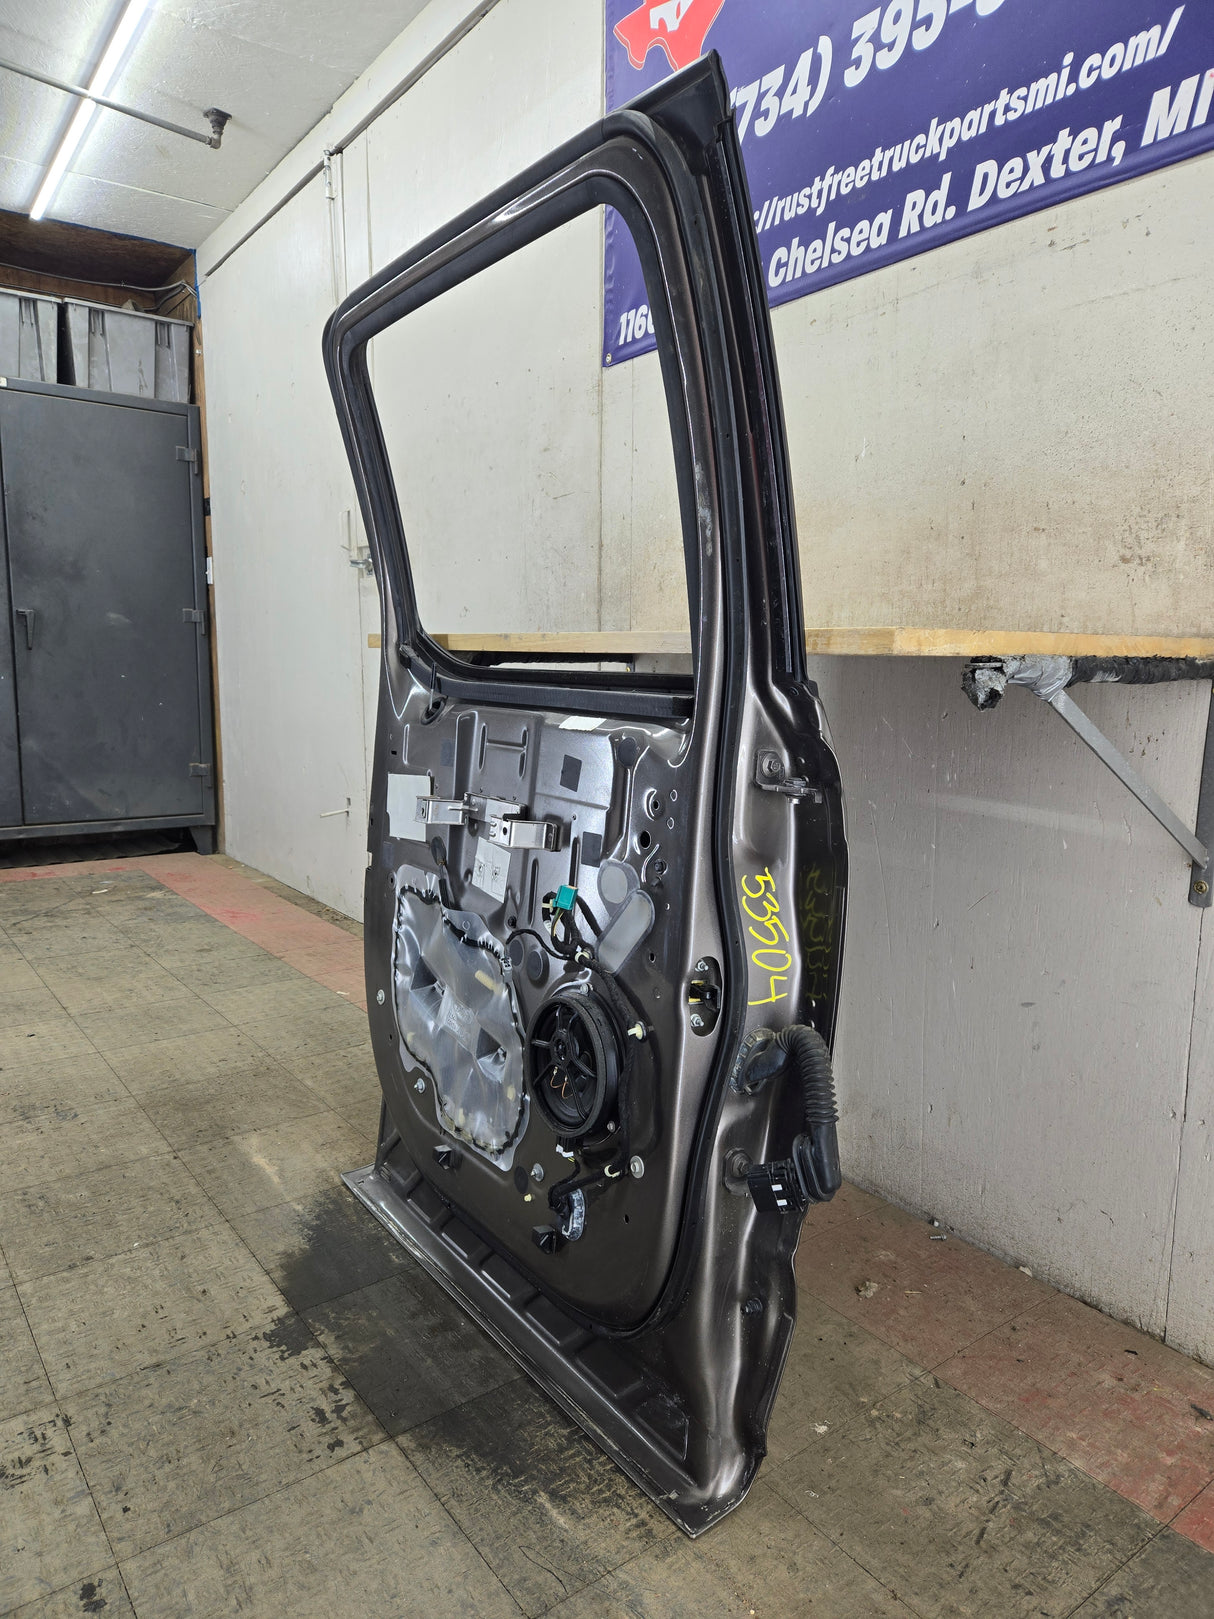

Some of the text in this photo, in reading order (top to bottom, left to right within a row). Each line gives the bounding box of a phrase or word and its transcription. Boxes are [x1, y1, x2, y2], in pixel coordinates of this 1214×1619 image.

[730, 0, 1005, 146] 734) 395-
[768, 209, 893, 287] Chelsea
[899, 171, 956, 239] Rd.
[966, 114, 1126, 212] Dexter,
[1140, 67, 1214, 148] MI
[741, 867, 792, 1006] 53504
